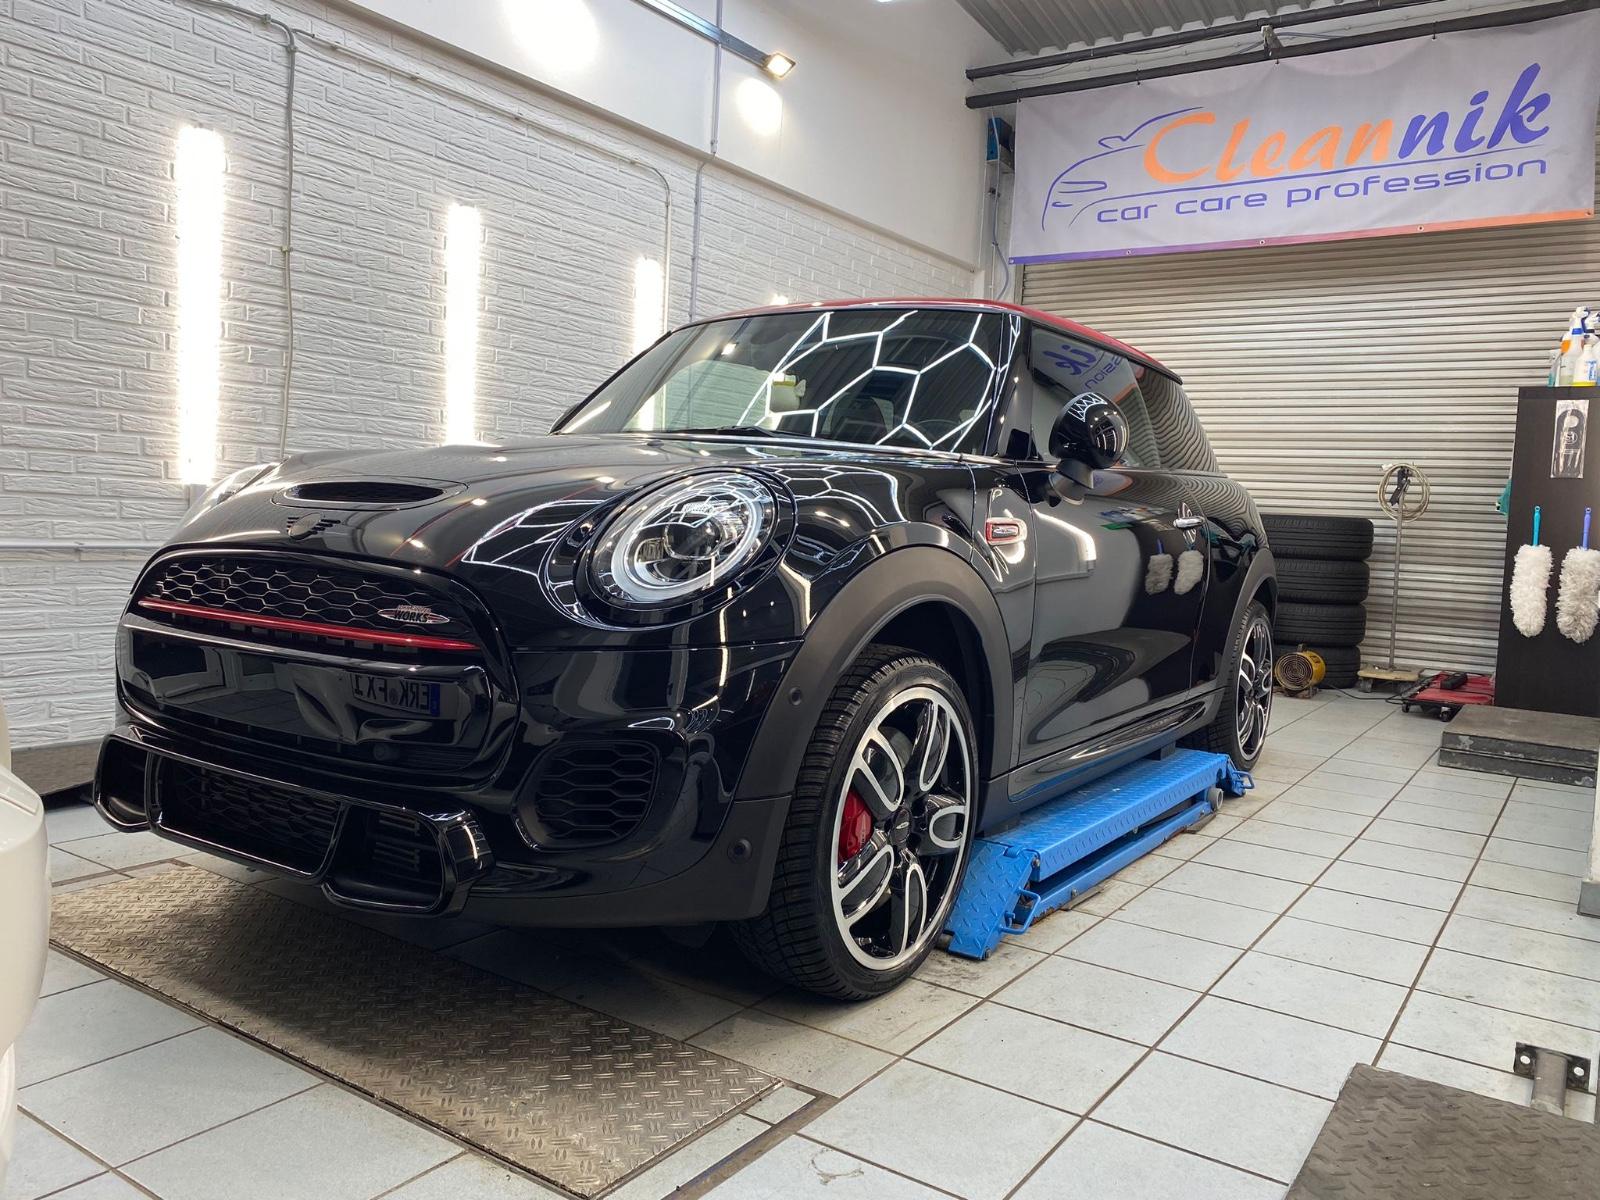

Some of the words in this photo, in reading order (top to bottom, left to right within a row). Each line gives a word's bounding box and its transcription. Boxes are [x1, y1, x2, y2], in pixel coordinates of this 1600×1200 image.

[1143, 63, 1551, 184] Cleannik
[1097, 202, 1157, 223] car
[1176, 194, 1267, 215] care
[1286, 156, 1547, 208] profession
[394, 609, 429, 623] WORKS
